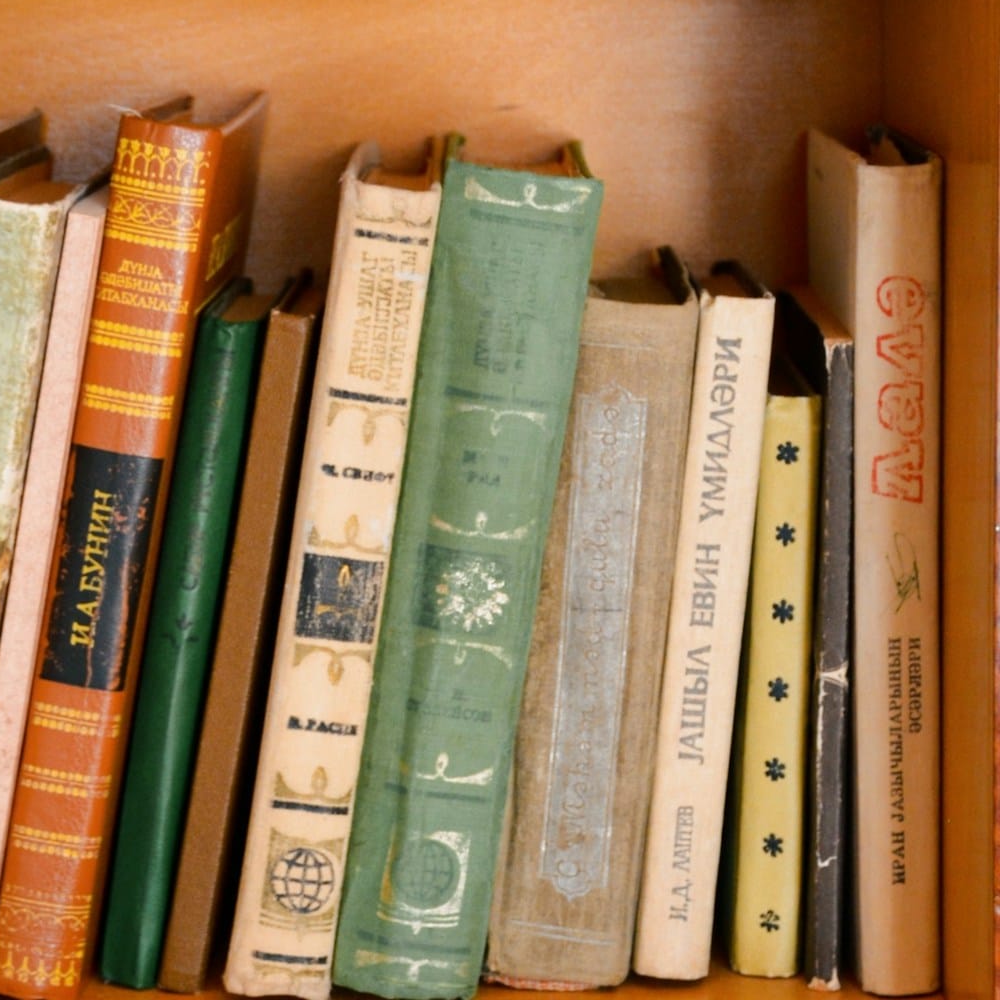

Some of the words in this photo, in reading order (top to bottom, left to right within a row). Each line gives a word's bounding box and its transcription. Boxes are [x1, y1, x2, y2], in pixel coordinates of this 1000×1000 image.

[688, 542, 722, 629] ЕВИН
[677, 645, 711, 765] ЈАШЫЛ
[908, 637, 922, 733] ӘСӘРЛӘРИ
[672, 805, 695, 872] ЛАПТЕВ
[891, 830, 906, 885] ИРАН
